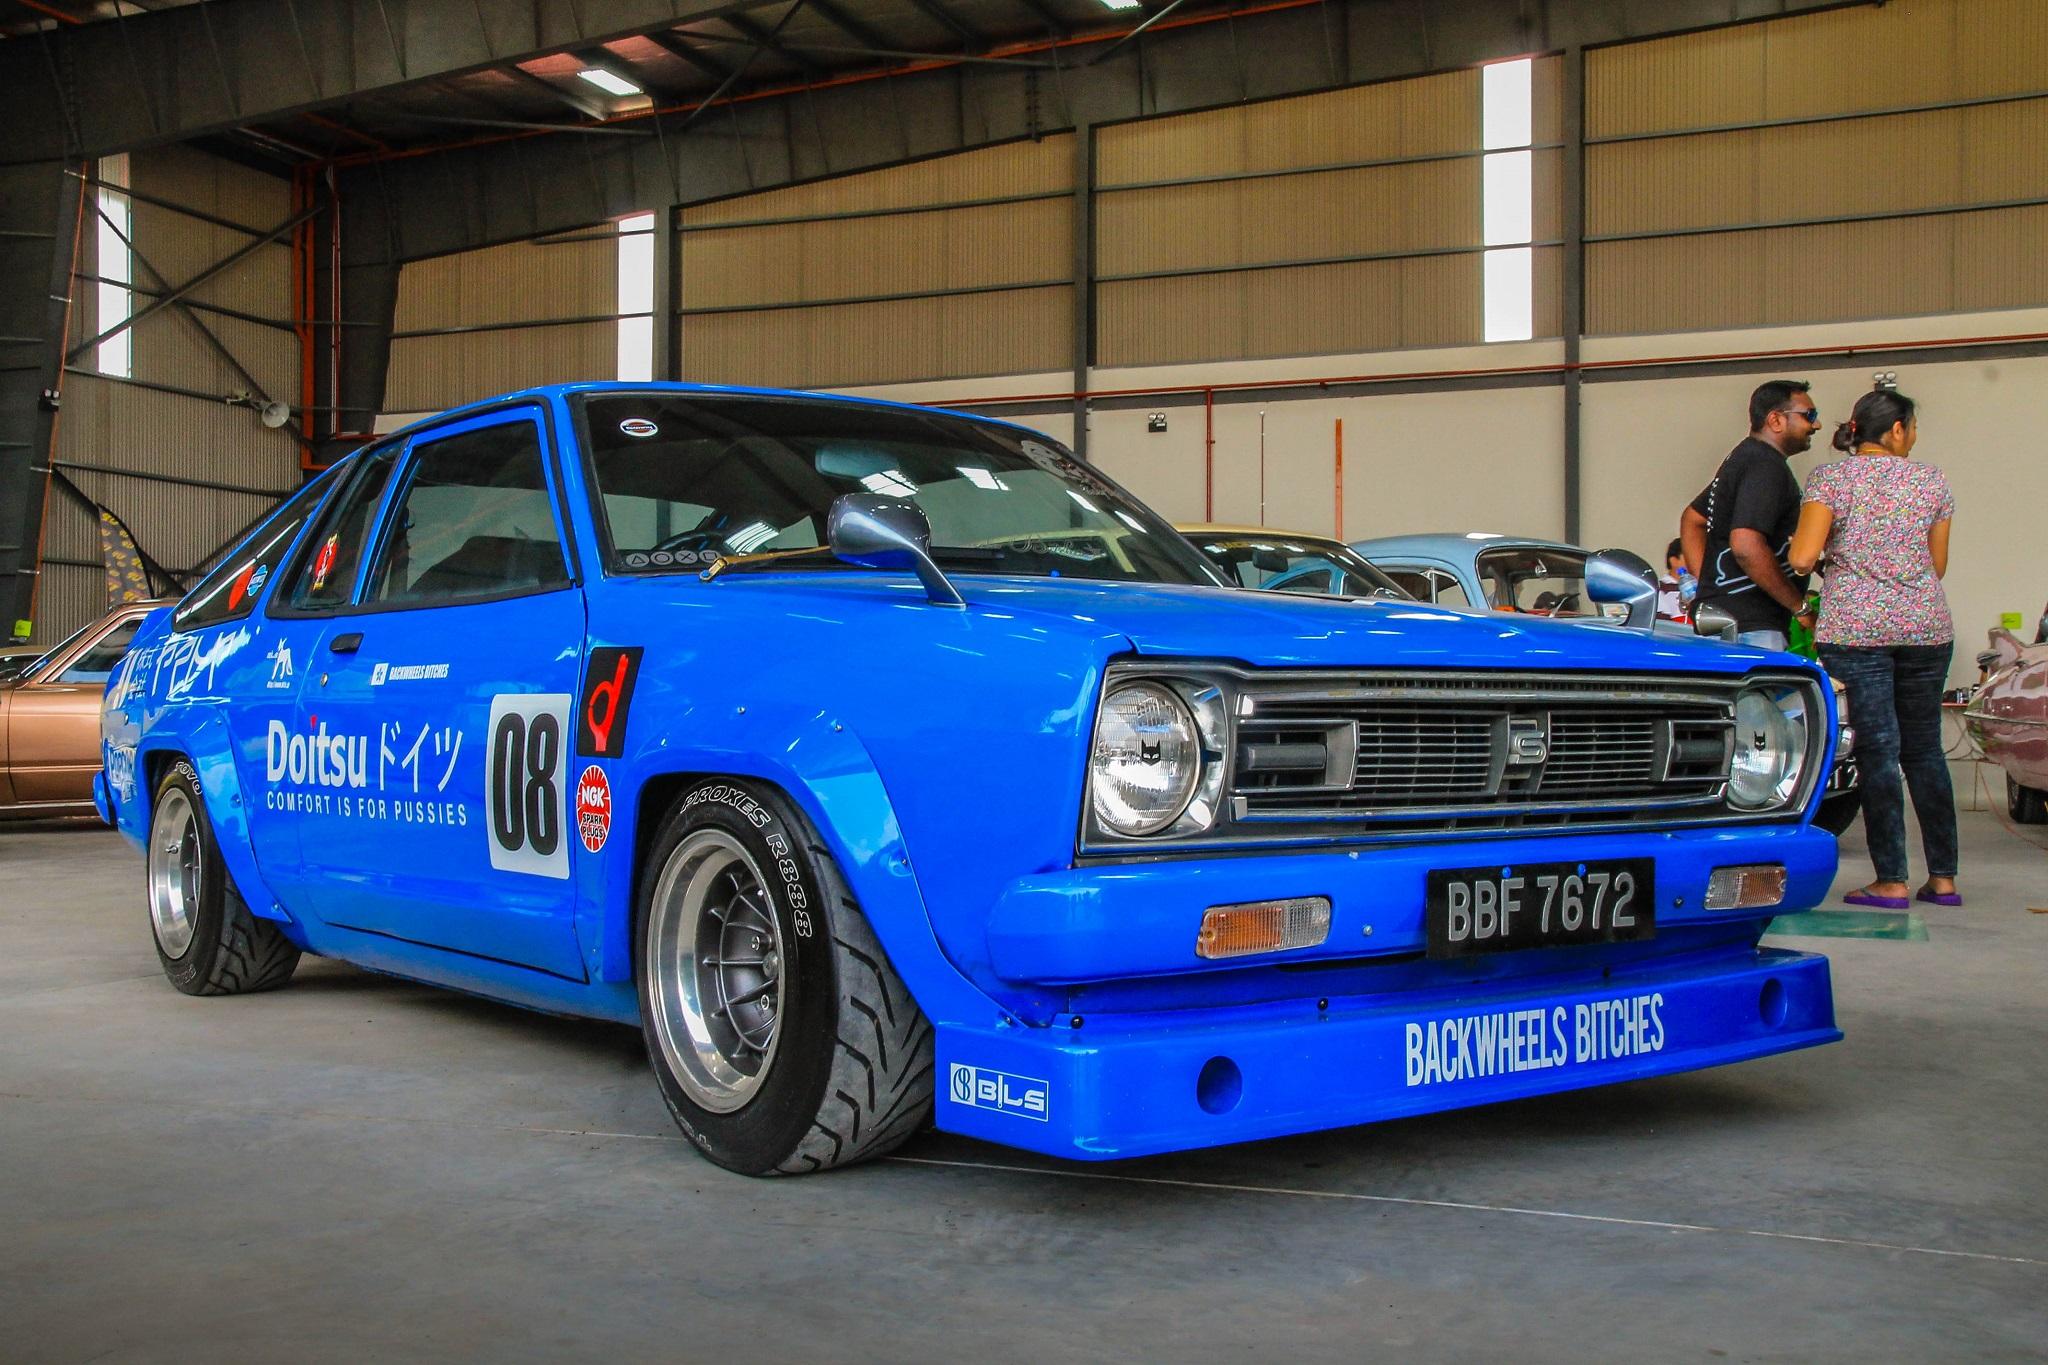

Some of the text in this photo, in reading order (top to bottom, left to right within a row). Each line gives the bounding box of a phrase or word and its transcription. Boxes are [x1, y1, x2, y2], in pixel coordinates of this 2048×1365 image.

[267, 714, 367, 788] Doitsu
[379, 720, 463, 793] ドイツ
[493, 712, 559, 856] 08
[267, 790, 467, 827] COMFORT IS FOR PUSSIES
[582, 785, 605, 808] NGK
[582, 813, 603, 825] SPARK
[583, 826, 605, 839] PLUGS
[680, 785, 812, 938] PROXES R888
[1448, 872, 1636, 942] BBF 7672
[1406, 993, 1665, 1087] BACKWHEELS BITCHES
